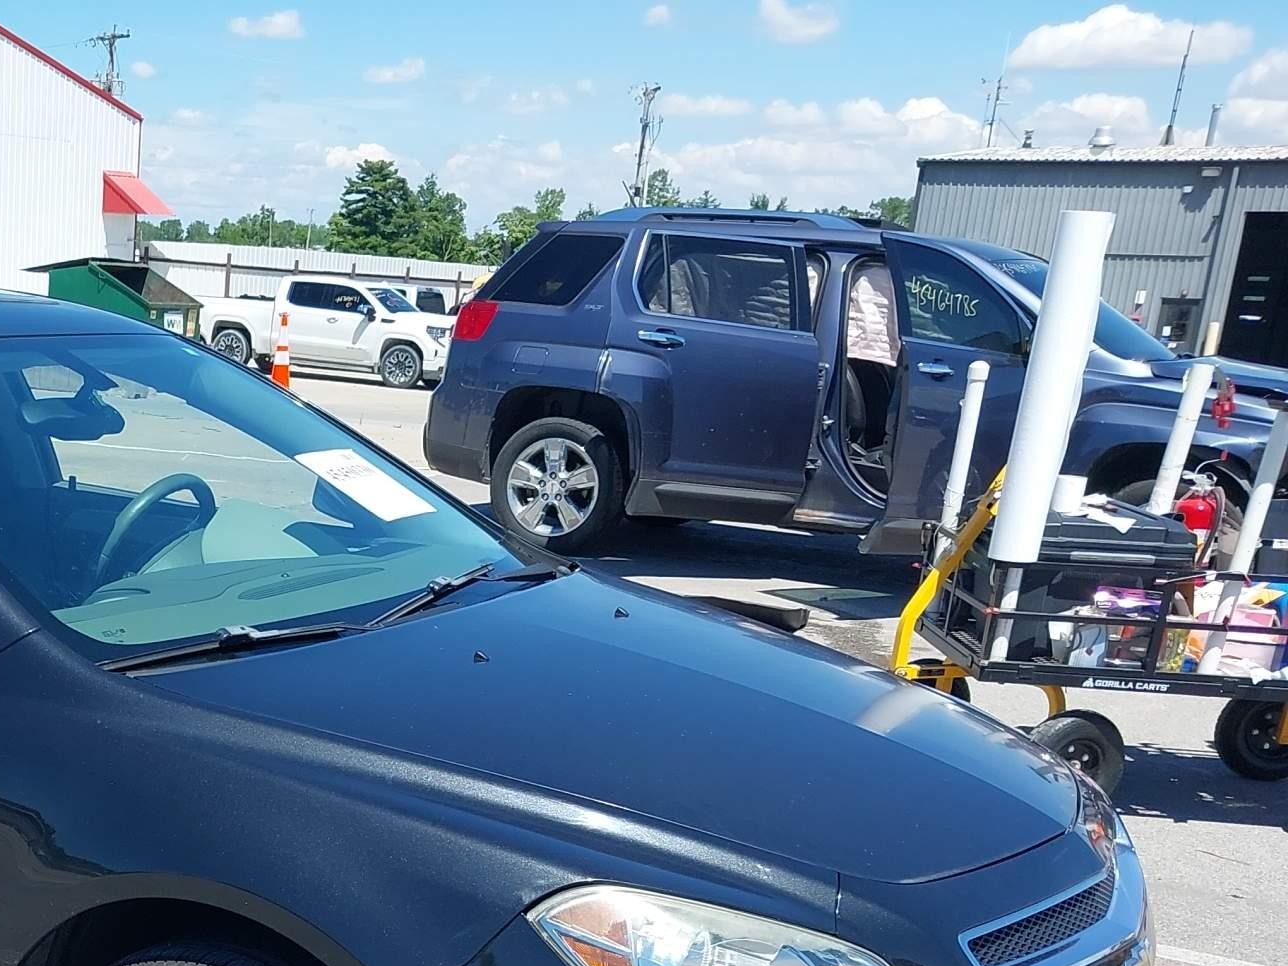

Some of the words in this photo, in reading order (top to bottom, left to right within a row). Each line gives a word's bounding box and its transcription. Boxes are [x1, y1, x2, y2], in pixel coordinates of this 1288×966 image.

[911, 275, 980, 317] 45464785
[1094, 679, 1133, 690] GORILLA
[1135, 682, 1170, 692] CARTS
